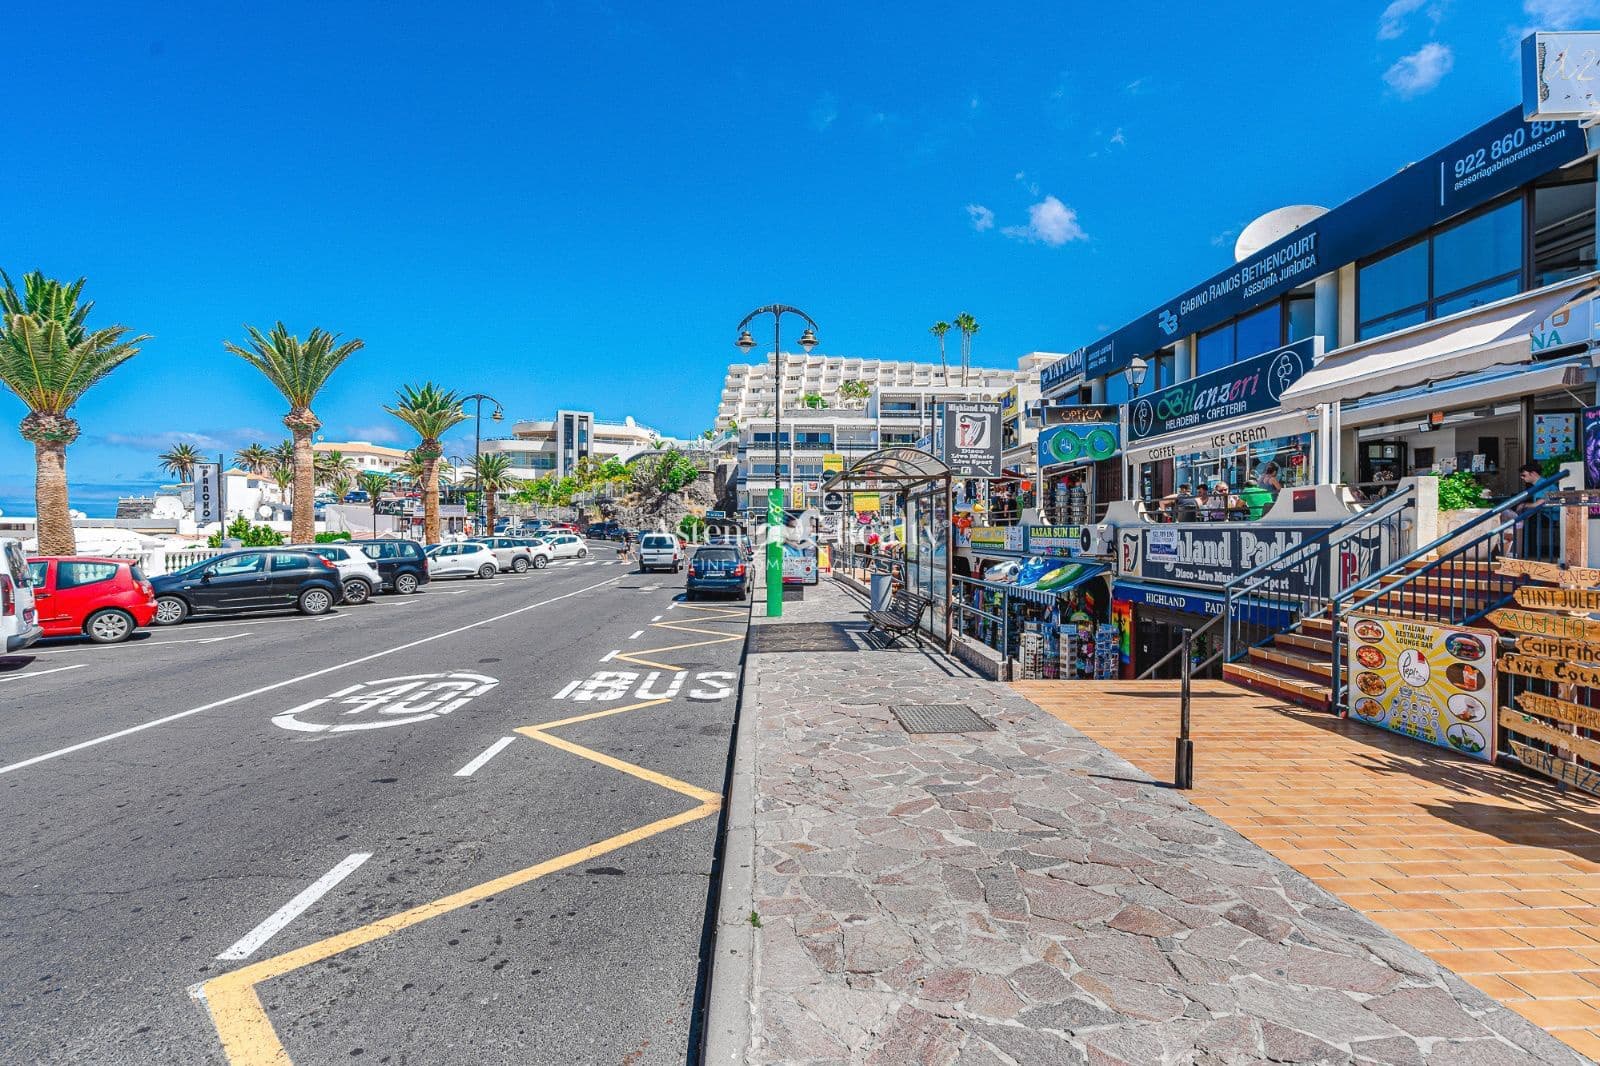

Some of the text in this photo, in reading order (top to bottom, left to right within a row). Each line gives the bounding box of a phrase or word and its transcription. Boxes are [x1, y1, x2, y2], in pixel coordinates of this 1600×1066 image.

[1455, 119, 1566, 178] 922 860 85
[1180, 232, 1317, 316] GABINO RAMOS BETHENCOURT
[1047, 349, 1083, 381] TATTOO
[1156, 367, 1262, 421] Bilanzeri
[1206, 400, 1247, 420] CAFETERIA
[1211, 425, 1268, 449] ICE CREAM
[1148, 445, 1176, 460] COFFEE
[1031, 527, 1051, 538] BAZAR
[1053, 527, 1068, 538] SUN
[1175, 567, 1194, 580] Disco
[1198, 569, 1213, 582] Live
[1145, 592, 1186, 608] HIGHLAND
[1520, 589, 1557, 607] MINT
[1395, 629, 1434, 640] RESTAURANT
[1402, 623, 1426, 633] ITALIAN
[1499, 612, 1586, 641] MOJITO
[1396, 636, 1433, 650] LOUNGE BAR
[552, 670, 738, 702] BUS
[338, 680, 463, 716] 40
[1521, 747, 1554, 775] GIN
